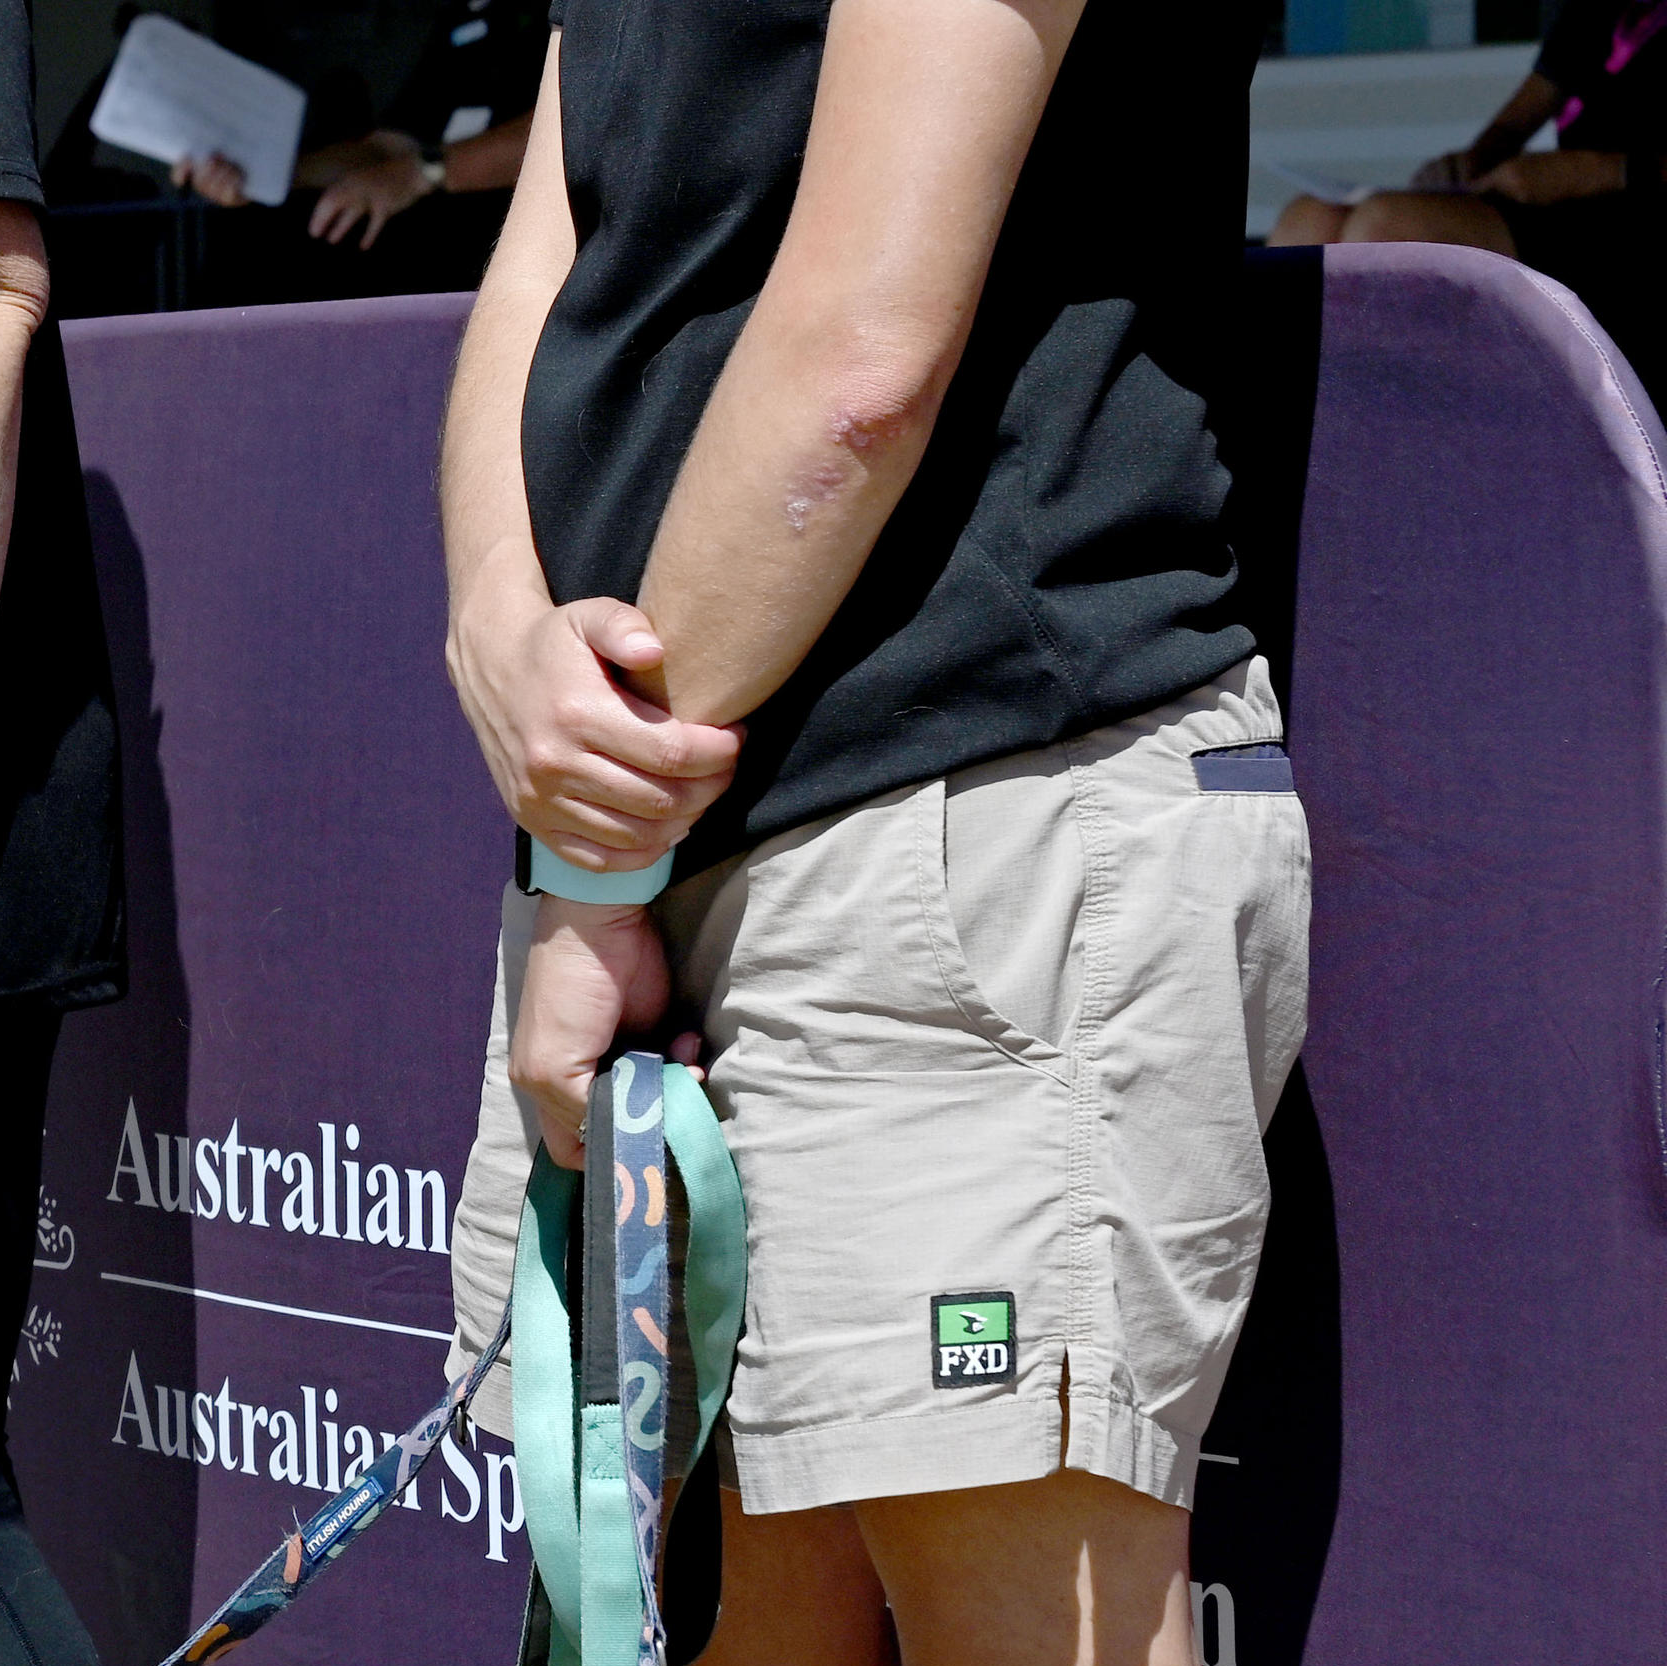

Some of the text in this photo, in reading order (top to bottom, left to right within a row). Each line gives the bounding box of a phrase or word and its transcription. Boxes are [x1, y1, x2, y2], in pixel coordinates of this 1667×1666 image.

[107, 1096, 450, 1254] Australian
[307, 1489, 371, 1554] TYLISH HOUND
